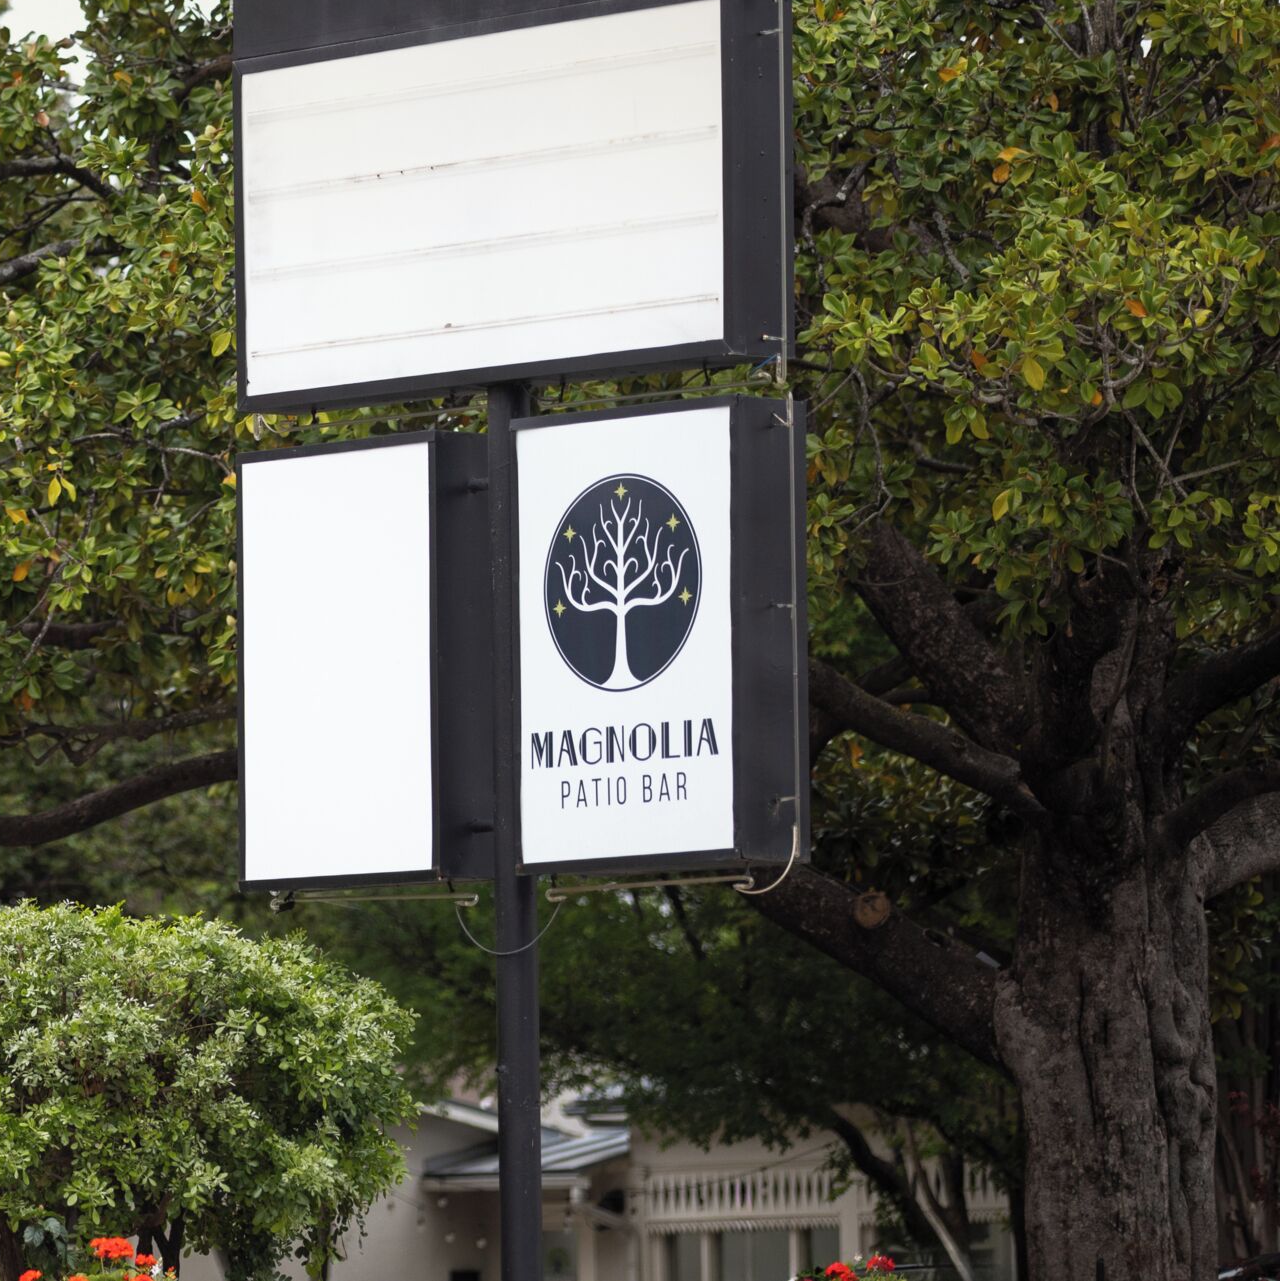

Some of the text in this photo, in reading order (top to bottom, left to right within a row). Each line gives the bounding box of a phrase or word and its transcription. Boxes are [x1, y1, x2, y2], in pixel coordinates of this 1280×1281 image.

[531, 717, 719, 770] MAGNOLIA
[561, 771, 687, 809] PATIO BAR
